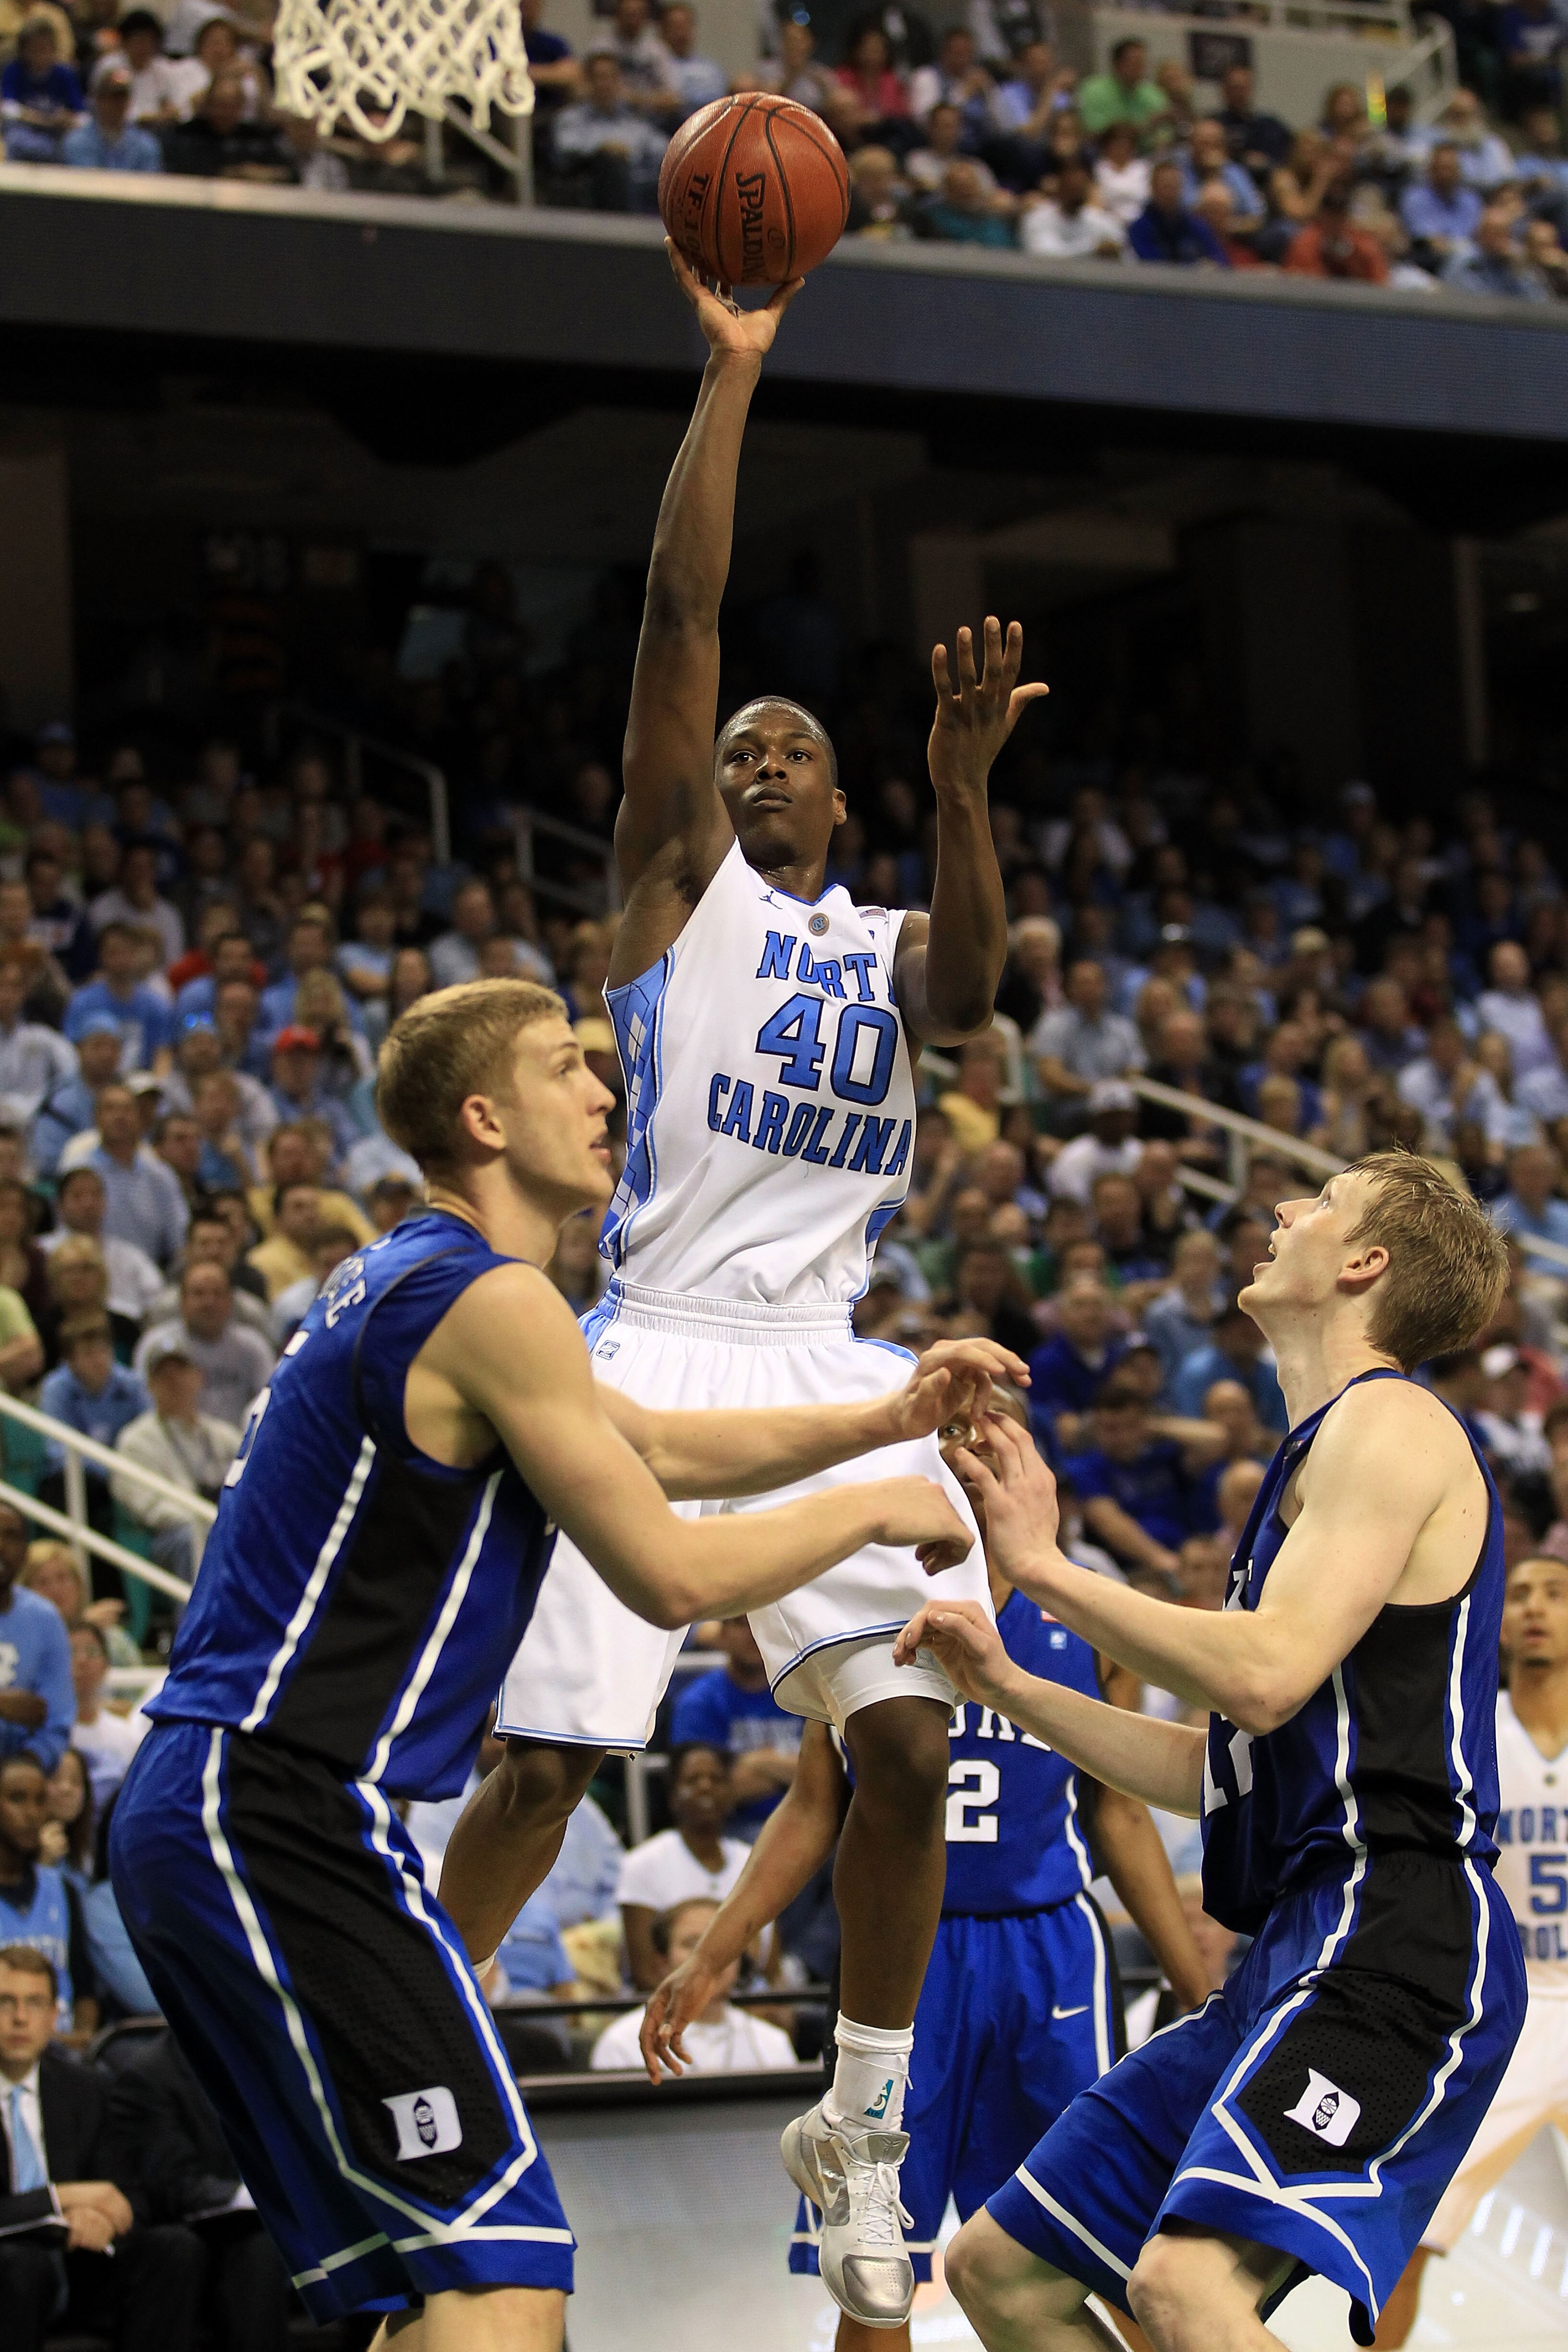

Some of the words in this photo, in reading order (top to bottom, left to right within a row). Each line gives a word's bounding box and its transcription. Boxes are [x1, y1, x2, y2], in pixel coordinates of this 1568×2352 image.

[755, 992, 898, 1106] 40
[708, 1073, 911, 1176] CAROLINA
[944, 1758, 1000, 1843] 2
[1529, 1854, 1568, 1913] 5
